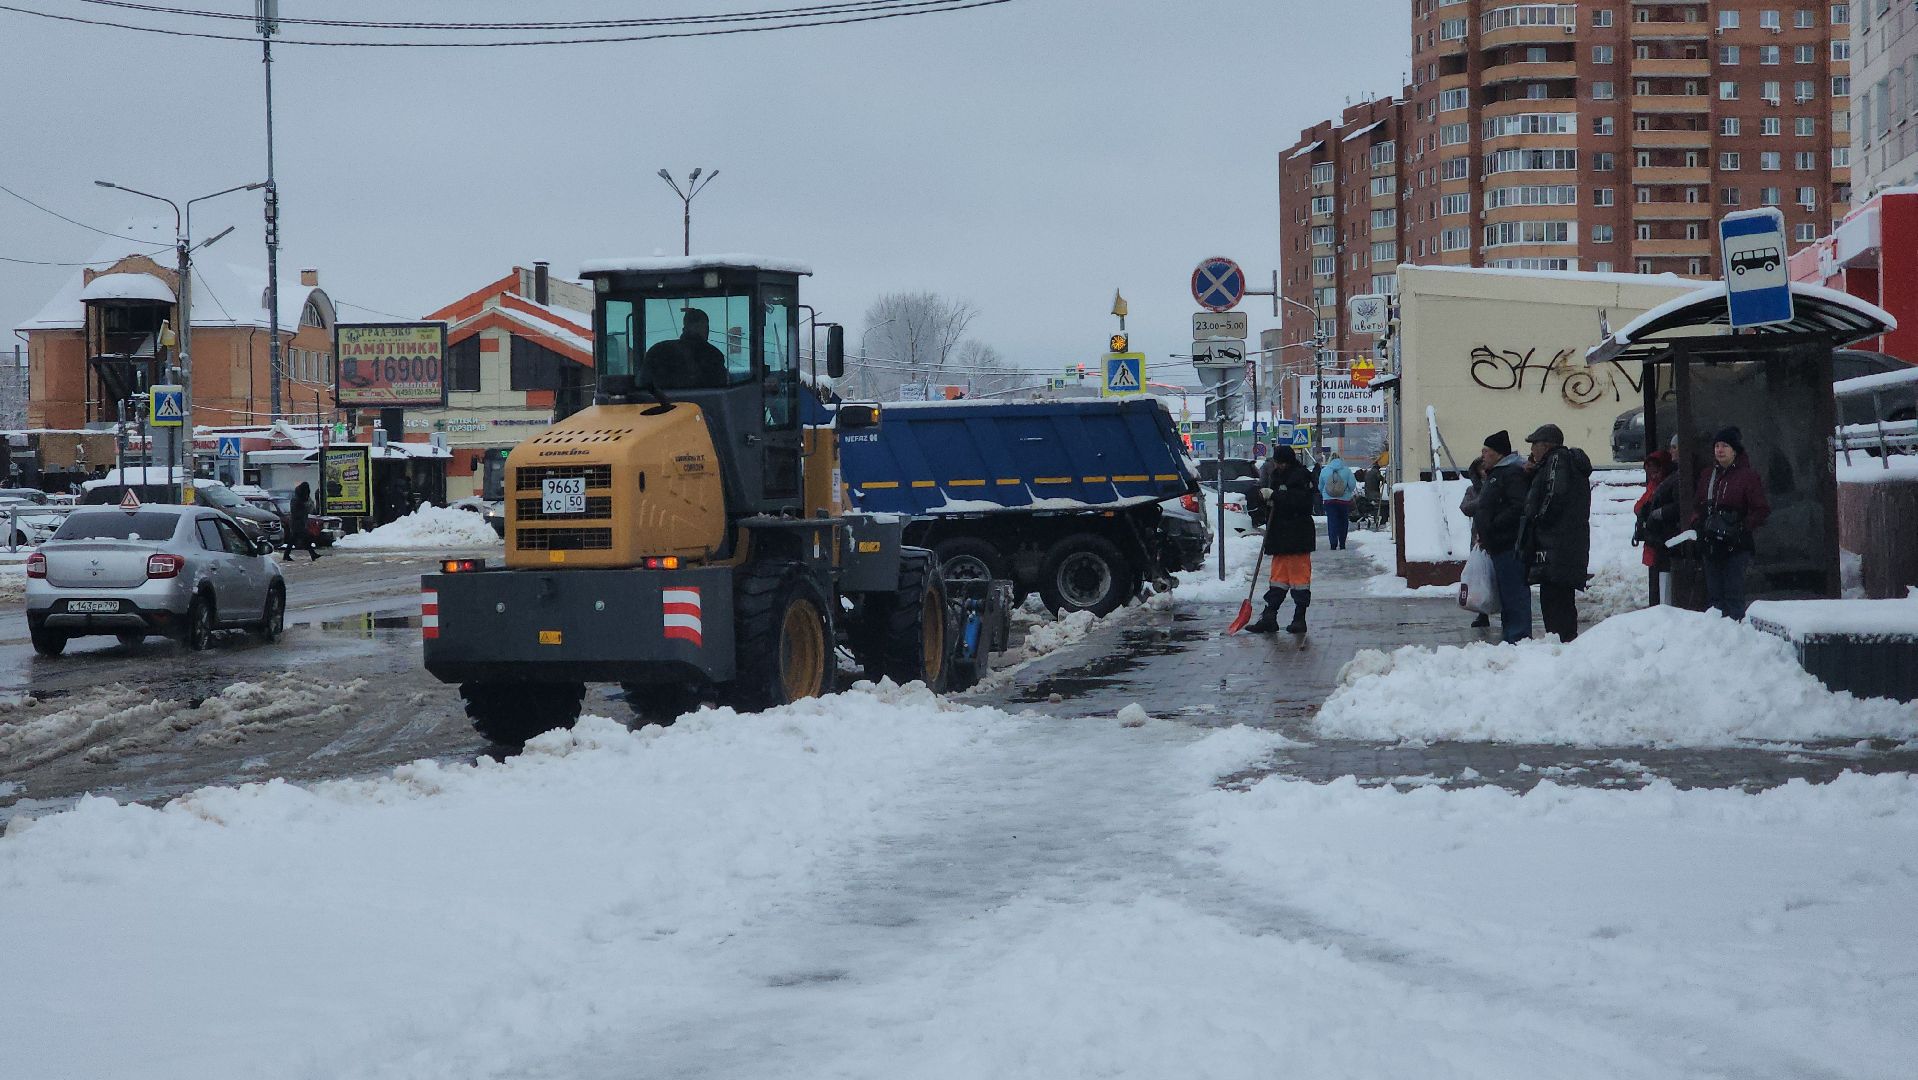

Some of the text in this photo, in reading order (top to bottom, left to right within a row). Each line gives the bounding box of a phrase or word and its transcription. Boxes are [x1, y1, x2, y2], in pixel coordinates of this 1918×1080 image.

[342, 342, 438, 355] ПАМЯТНИКИ
[371, 356, 438, 383] 16900
[1310, 391, 1373, 400] МСТО СДАЕТСЯ
[1303, 405, 1309, 414] 8
[1337, 405, 1381, 414] 626-68-01
[447, 424, 487, 432] ГОРЗДРАВ
[547, 479, 580, 494] 9663
[569, 496, 582, 507] 50
